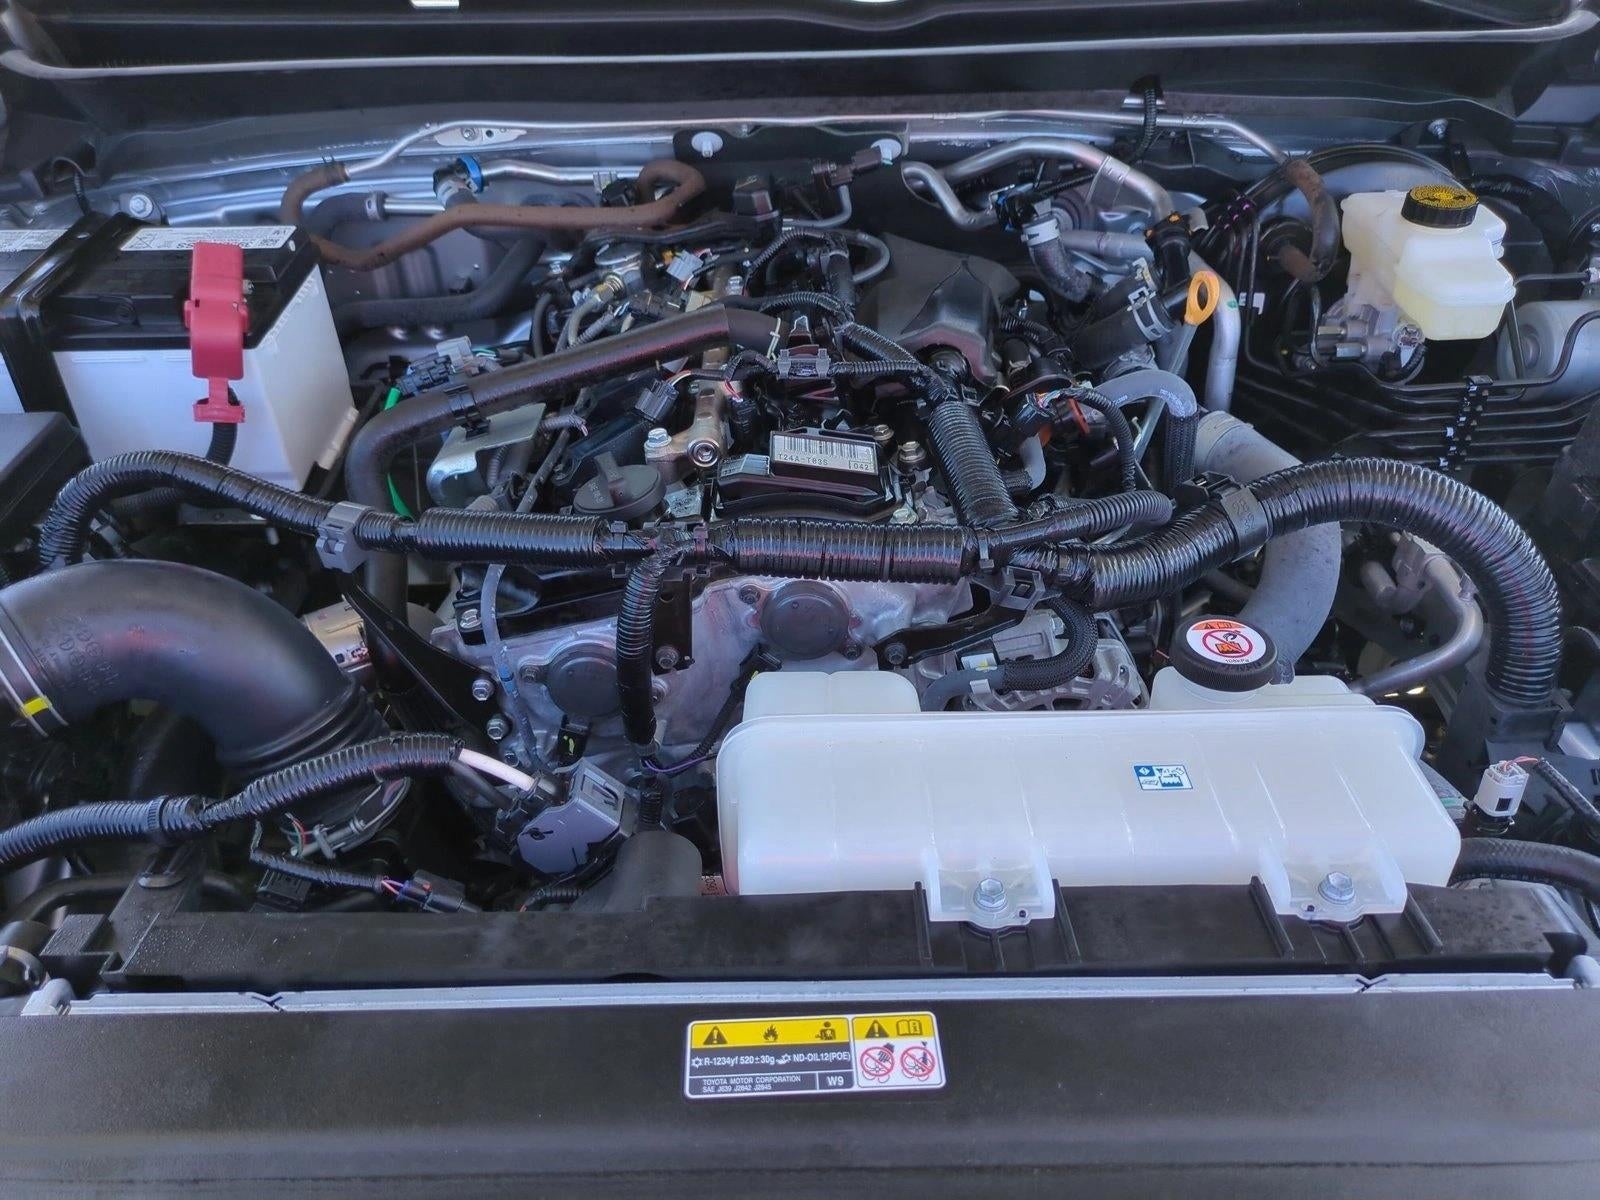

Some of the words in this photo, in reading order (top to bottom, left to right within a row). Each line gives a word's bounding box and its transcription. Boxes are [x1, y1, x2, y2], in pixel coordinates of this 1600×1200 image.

[704, 1056, 738, 1067] R-1234yf
[703, 1078, 728, 1086] TOYOTA
[730, 1077, 754, 1085] MOTOR
[755, 1075, 801, 1084] CORPORATION
[826, 1075, 845, 1087] W9
[702, 1085, 716, 1093] SAE
